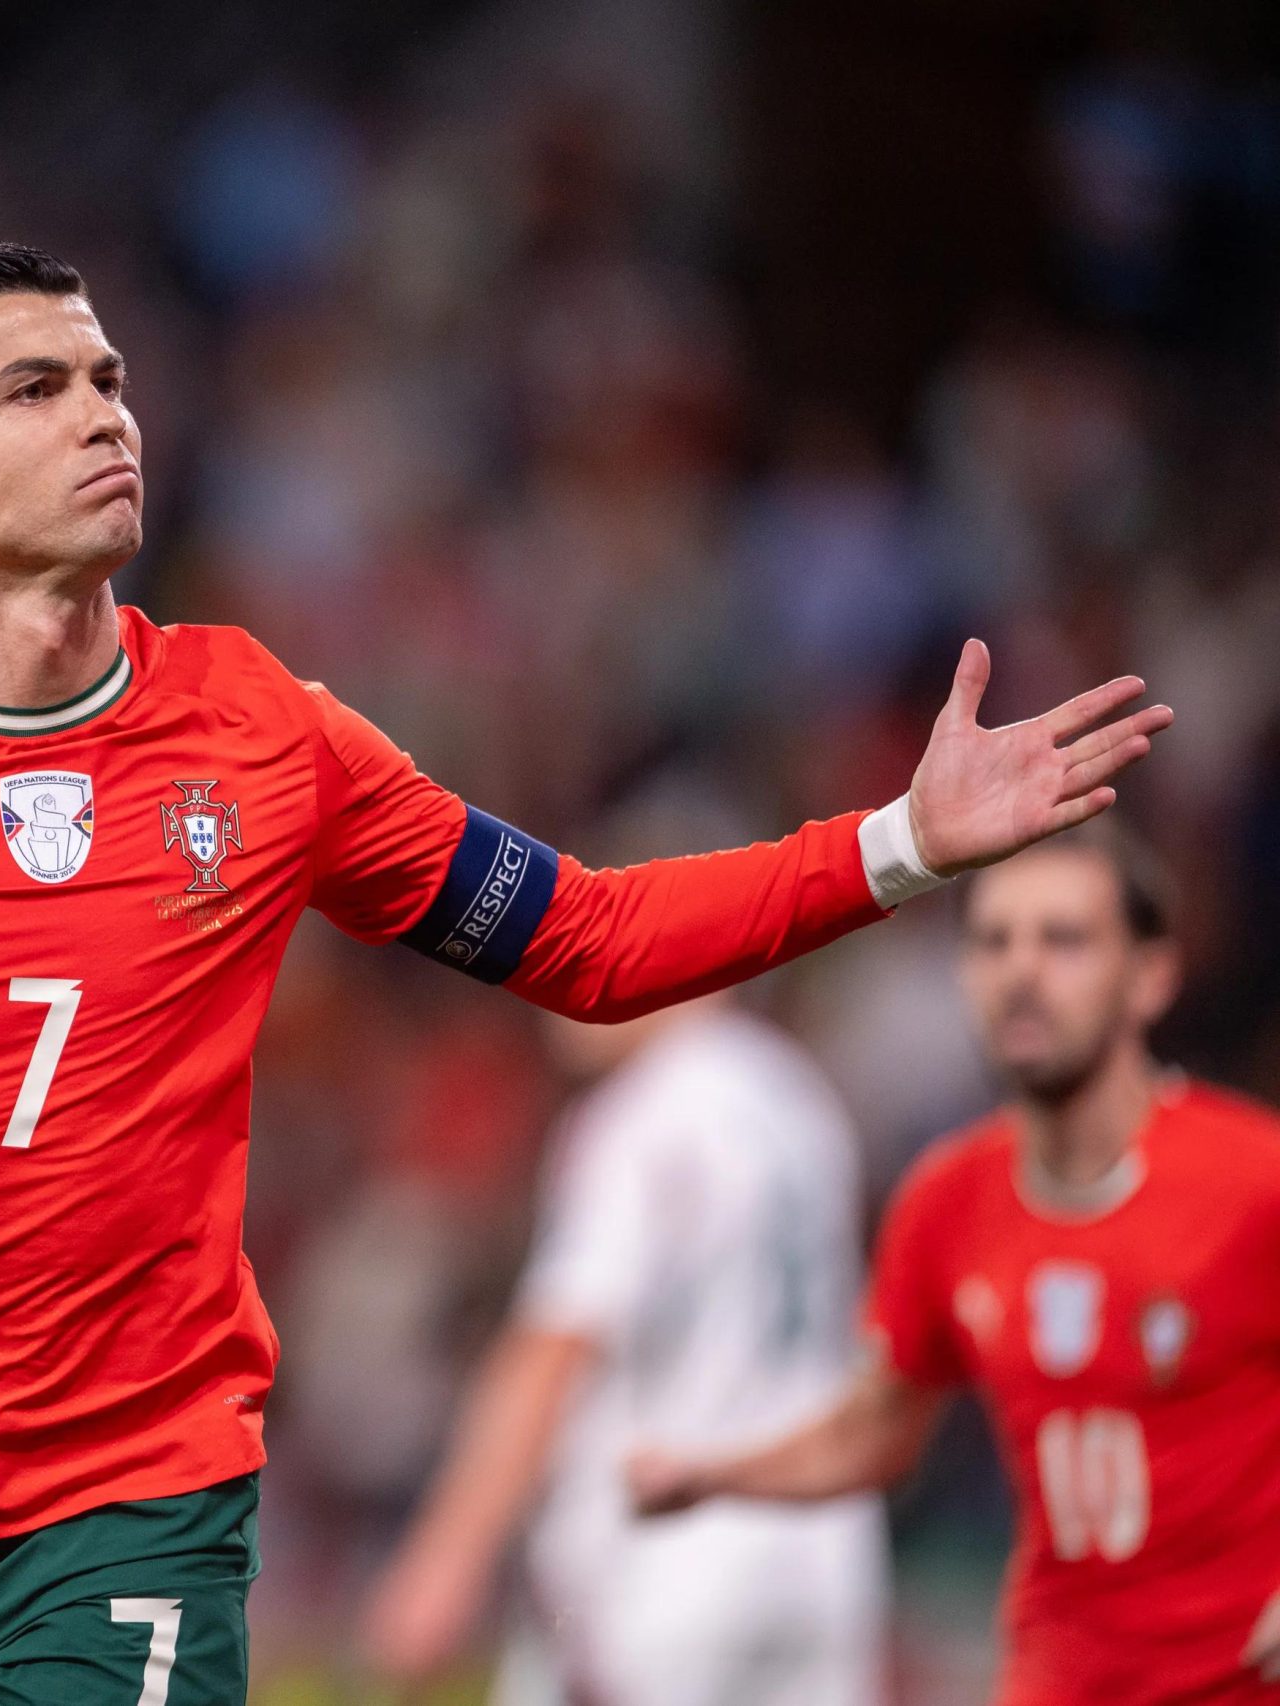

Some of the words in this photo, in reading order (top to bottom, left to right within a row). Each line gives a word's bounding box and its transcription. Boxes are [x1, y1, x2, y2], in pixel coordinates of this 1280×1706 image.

[4, 780, 24, 788] UEFA
[24, 775, 57, 784] NATIONS
[58, 775, 88, 786] LEAGUE
[29, 866, 59, 880] WINNER
[156, 907, 169, 920] 14
[463, 836, 524, 939] RESPECT
[0, 976, 84, 1149] 7
[1036, 1406, 1152, 1564] 10
[110, 1597, 184, 1706] 7
